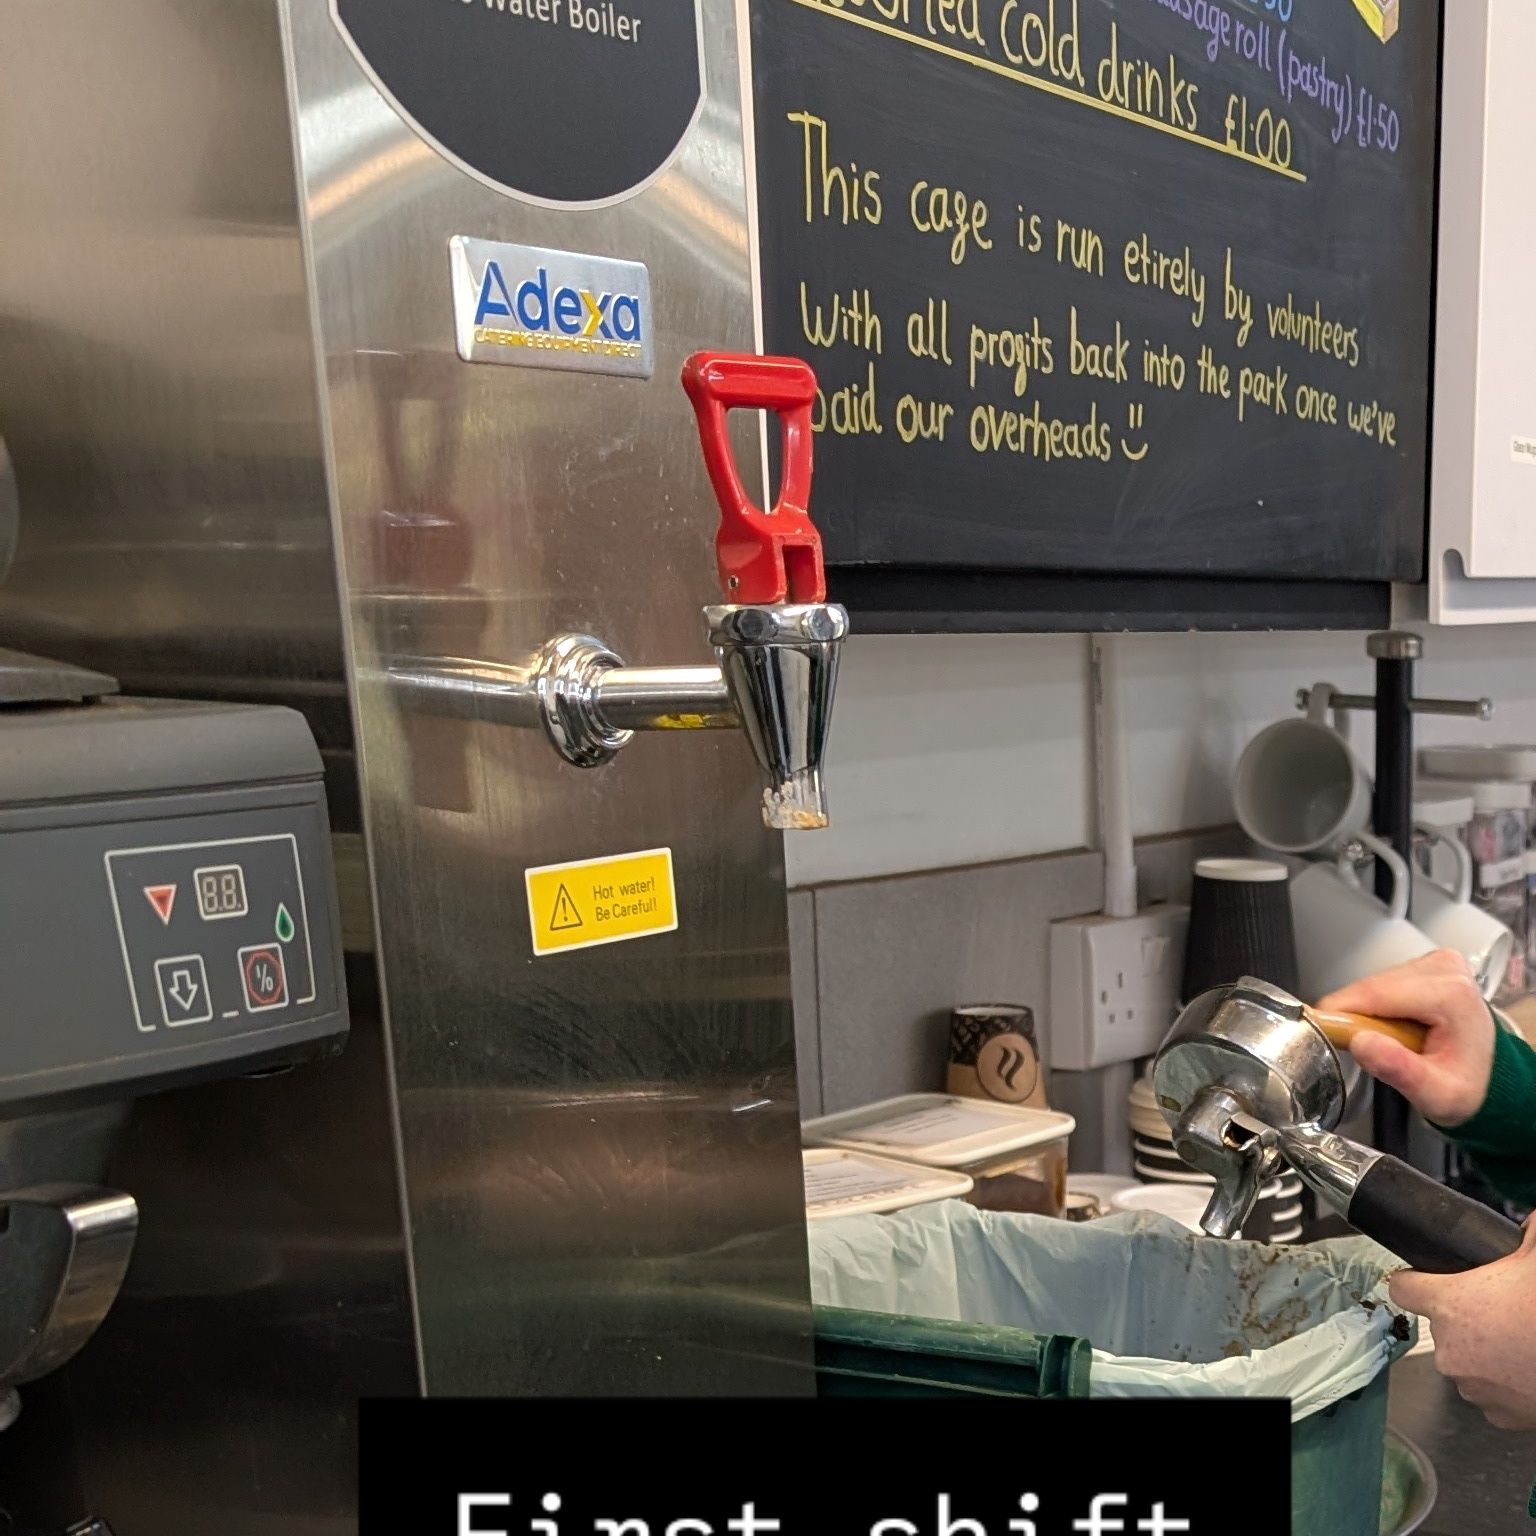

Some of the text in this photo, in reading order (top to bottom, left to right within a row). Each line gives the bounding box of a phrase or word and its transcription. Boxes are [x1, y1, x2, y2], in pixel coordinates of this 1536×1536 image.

[568, 0, 641, 42] Boiler
[1001, 0, 1084, 87] cold
[1098, 22, 1198, 131] drinks
[1235, 20, 1271, 71] roll
[1278, 29, 1352, 144] (pastry)
[787, 110, 882, 225] This
[1018, 205, 1042, 253] is
[1057, 219, 1104, 277] run
[1124, 233, 1205, 328] etirely
[1225, 247, 1253, 348] by
[1267, 292, 1359, 367] volunteers
[474, 259, 641, 341] Adexa
[801, 281, 882, 354] With
[907, 298, 952, 366] all
[1071, 305, 1130, 384] back
[1144, 339, 1185, 390] into
[1197, 344, 1231, 399] the
[1239, 366, 1288, 422] park
[1295, 384, 1337, 425] once
[1347, 400, 1397, 446] we've
[896, 395, 954, 443] our
[970, 400, 1111, 462] overheads
[593, 876, 655, 900] Hot water!
[595, 897, 657, 921] Be Careful!
